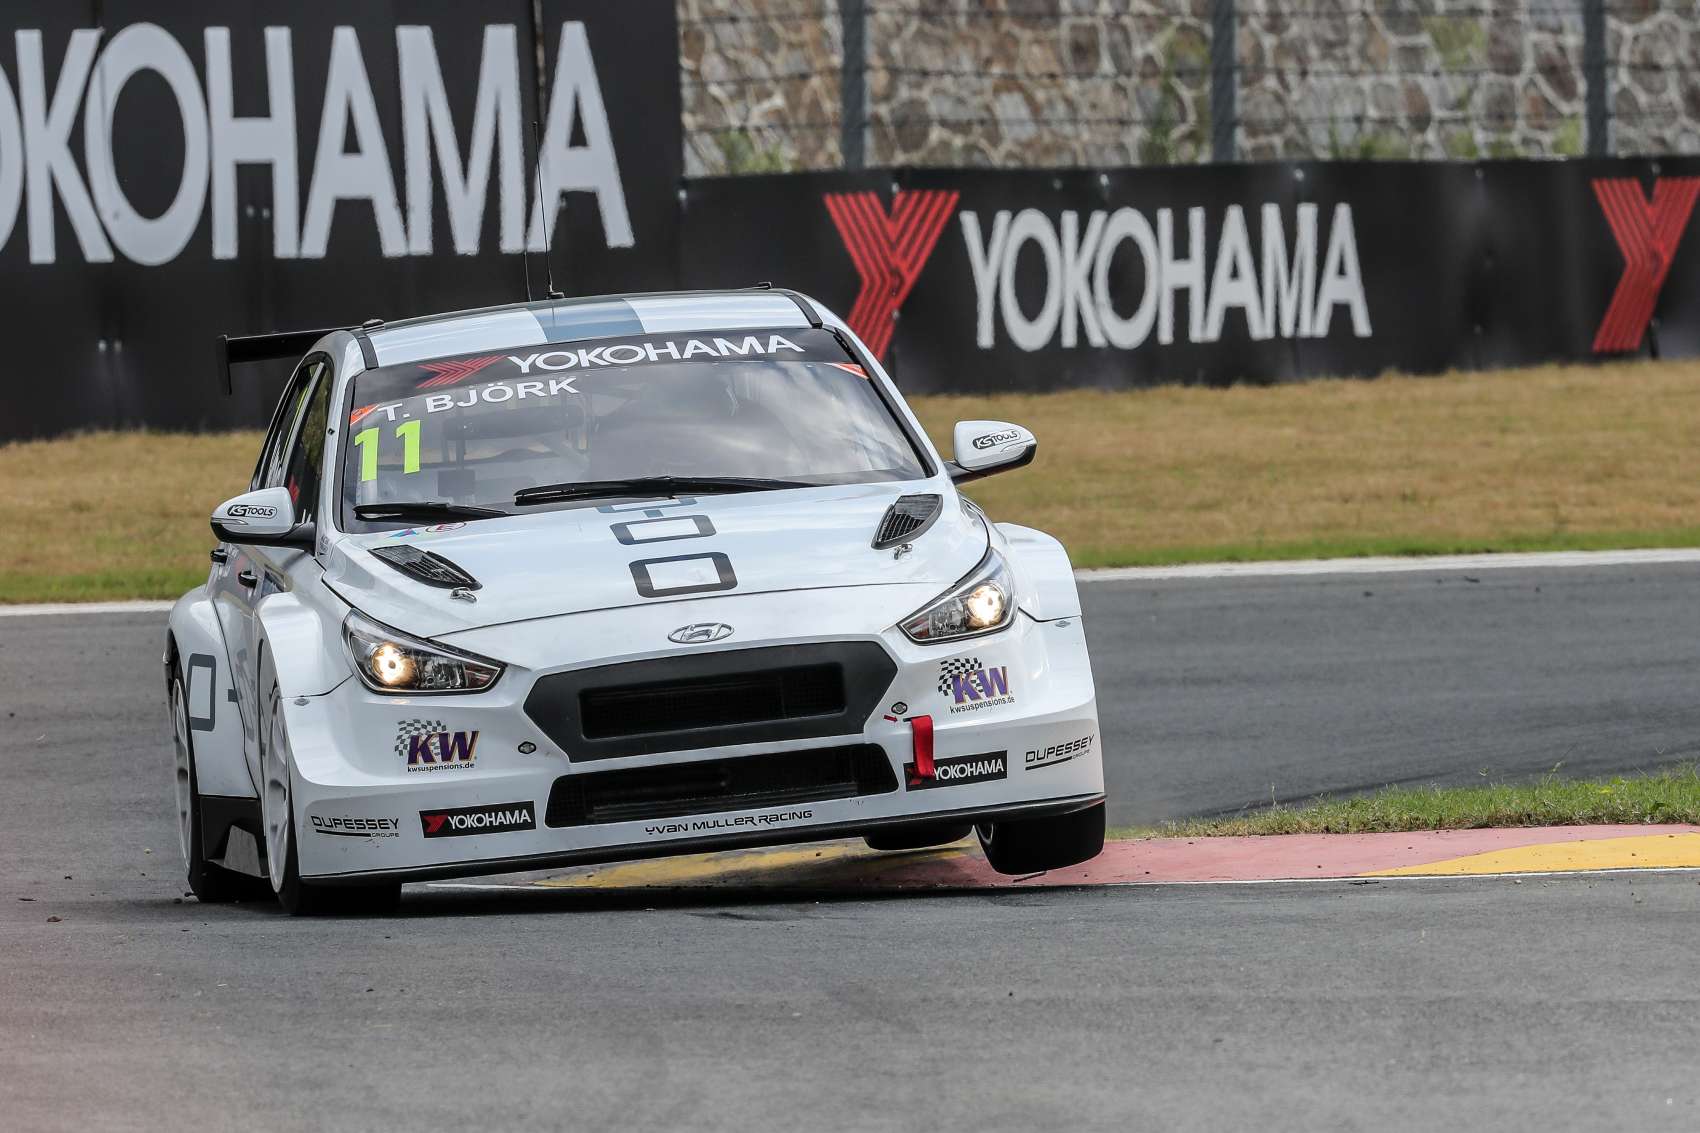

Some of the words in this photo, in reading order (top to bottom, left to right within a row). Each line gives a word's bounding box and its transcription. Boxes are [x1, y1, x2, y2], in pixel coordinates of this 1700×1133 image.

[0, 20, 635, 266] KOHAMA
[959, 201, 1373, 352] YOKOHAMA
[507, 333, 805, 375] YOKOHAMA
[377, 402, 411, 422] T.
[425, 377, 579, 414] BJÖRK
[354, 419, 421, 482] 11
[952, 665, 1009, 705] KW
[949, 695, 1016, 714] kwsuspensions.de
[407, 730, 480, 765] KW
[1024, 733, 1095, 763] DUPESSEY
[407, 761, 475, 773] kwsuspensions.de
[933, 758, 1005, 781] YOKOHAMA
[310, 815, 400, 830] DUPESSEY
[448, 808, 532, 830] YOKOHAMA
